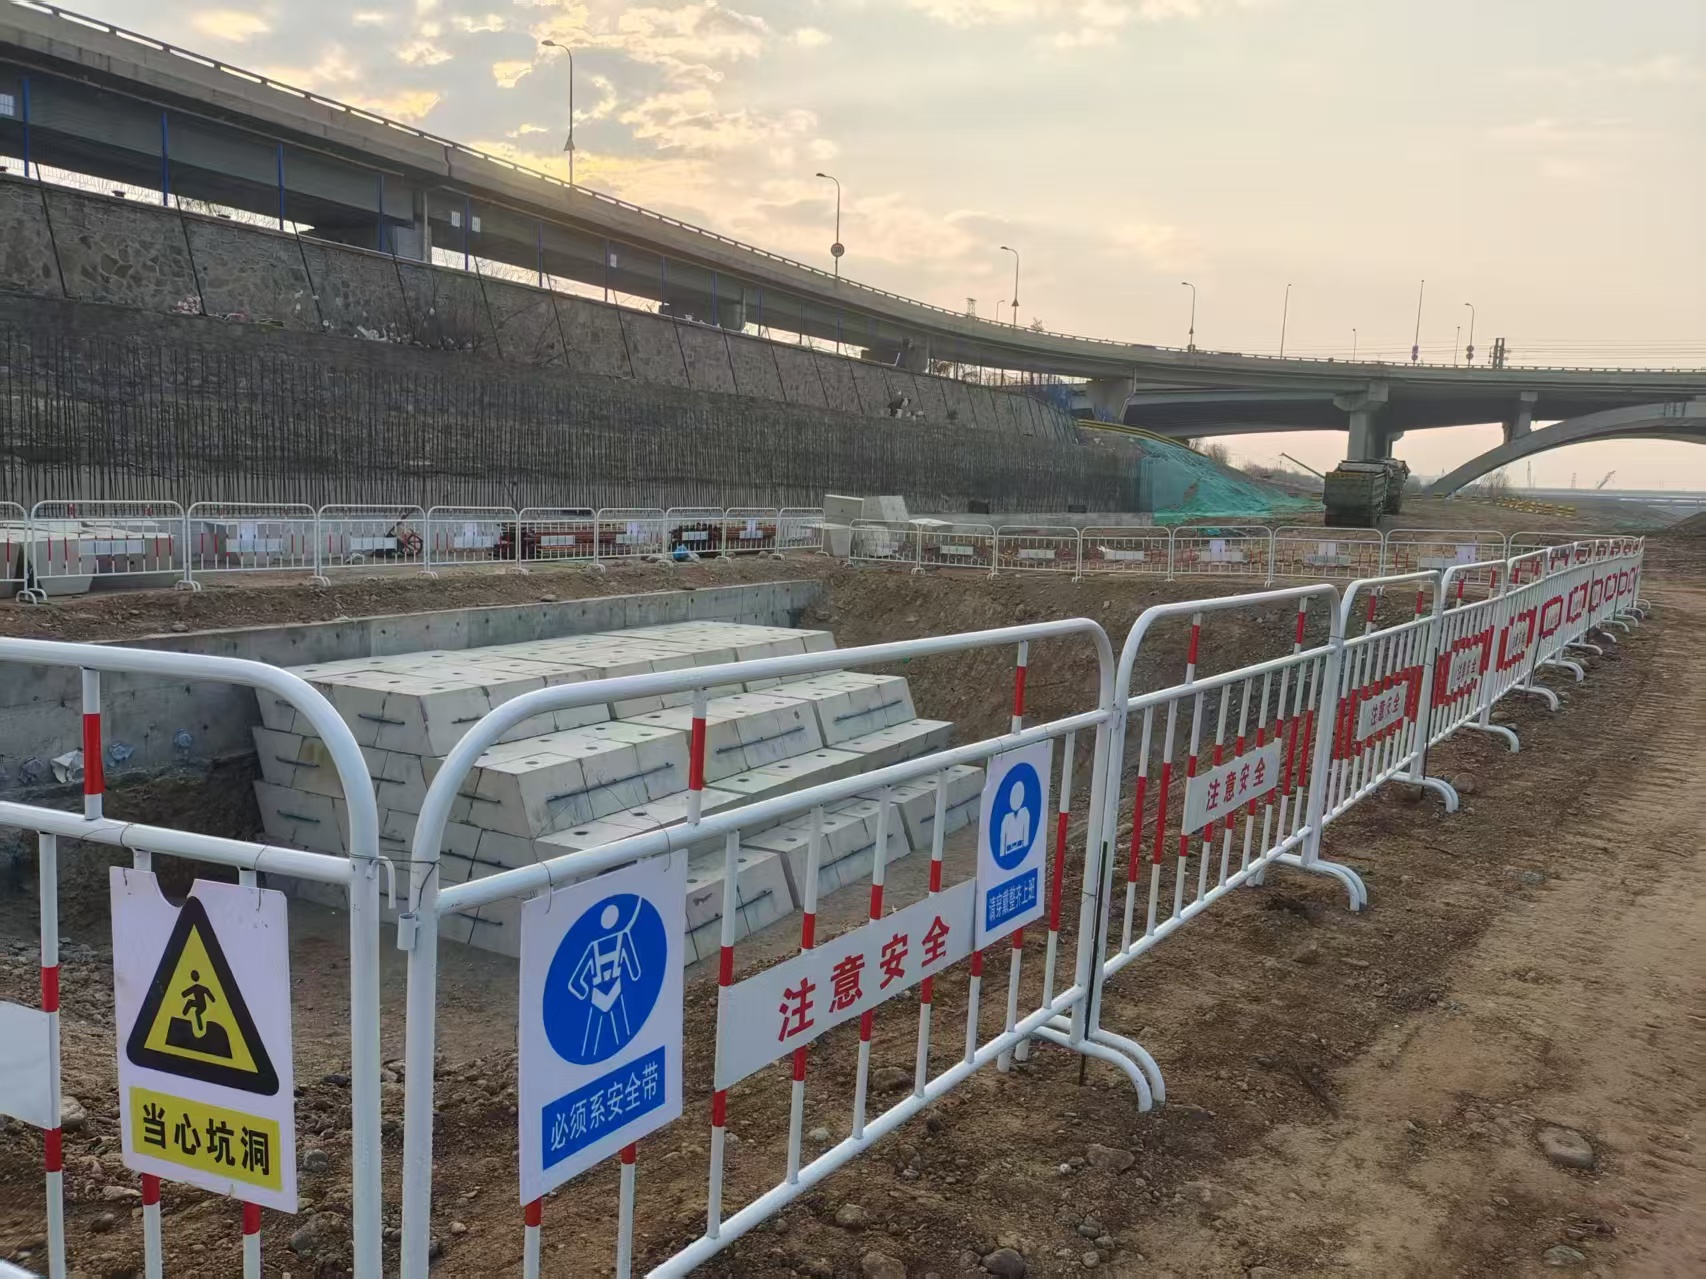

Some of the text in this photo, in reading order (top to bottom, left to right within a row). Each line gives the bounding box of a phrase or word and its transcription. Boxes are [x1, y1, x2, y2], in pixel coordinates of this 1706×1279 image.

[1205, 756, 1266, 812] 注意安全
[777, 915, 952, 1042] 注意安全
[142, 1102, 270, 1176] 当心坑洞
[550, 1060, 659, 1152] 必须系安全带
